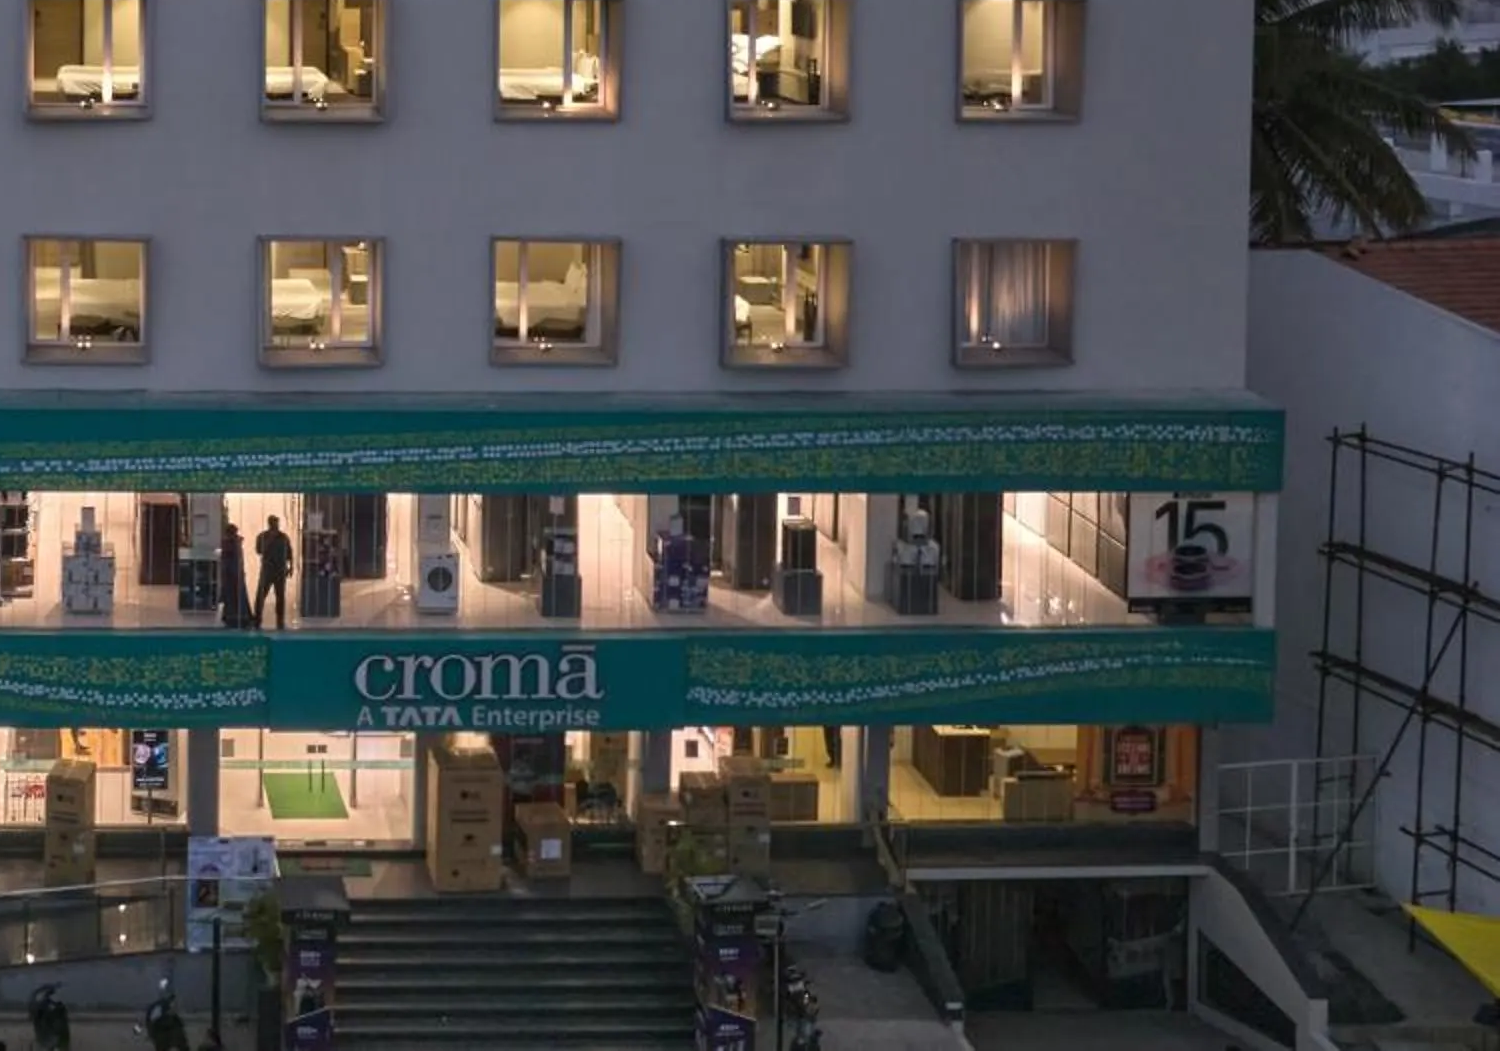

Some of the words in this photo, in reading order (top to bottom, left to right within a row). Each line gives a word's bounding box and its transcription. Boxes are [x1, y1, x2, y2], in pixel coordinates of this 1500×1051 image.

[1155, 501, 1229, 557] 15
[357, 706, 374, 726] A
[381, 706, 463, 726] TATA
[472, 705, 601, 731] Enterprise
